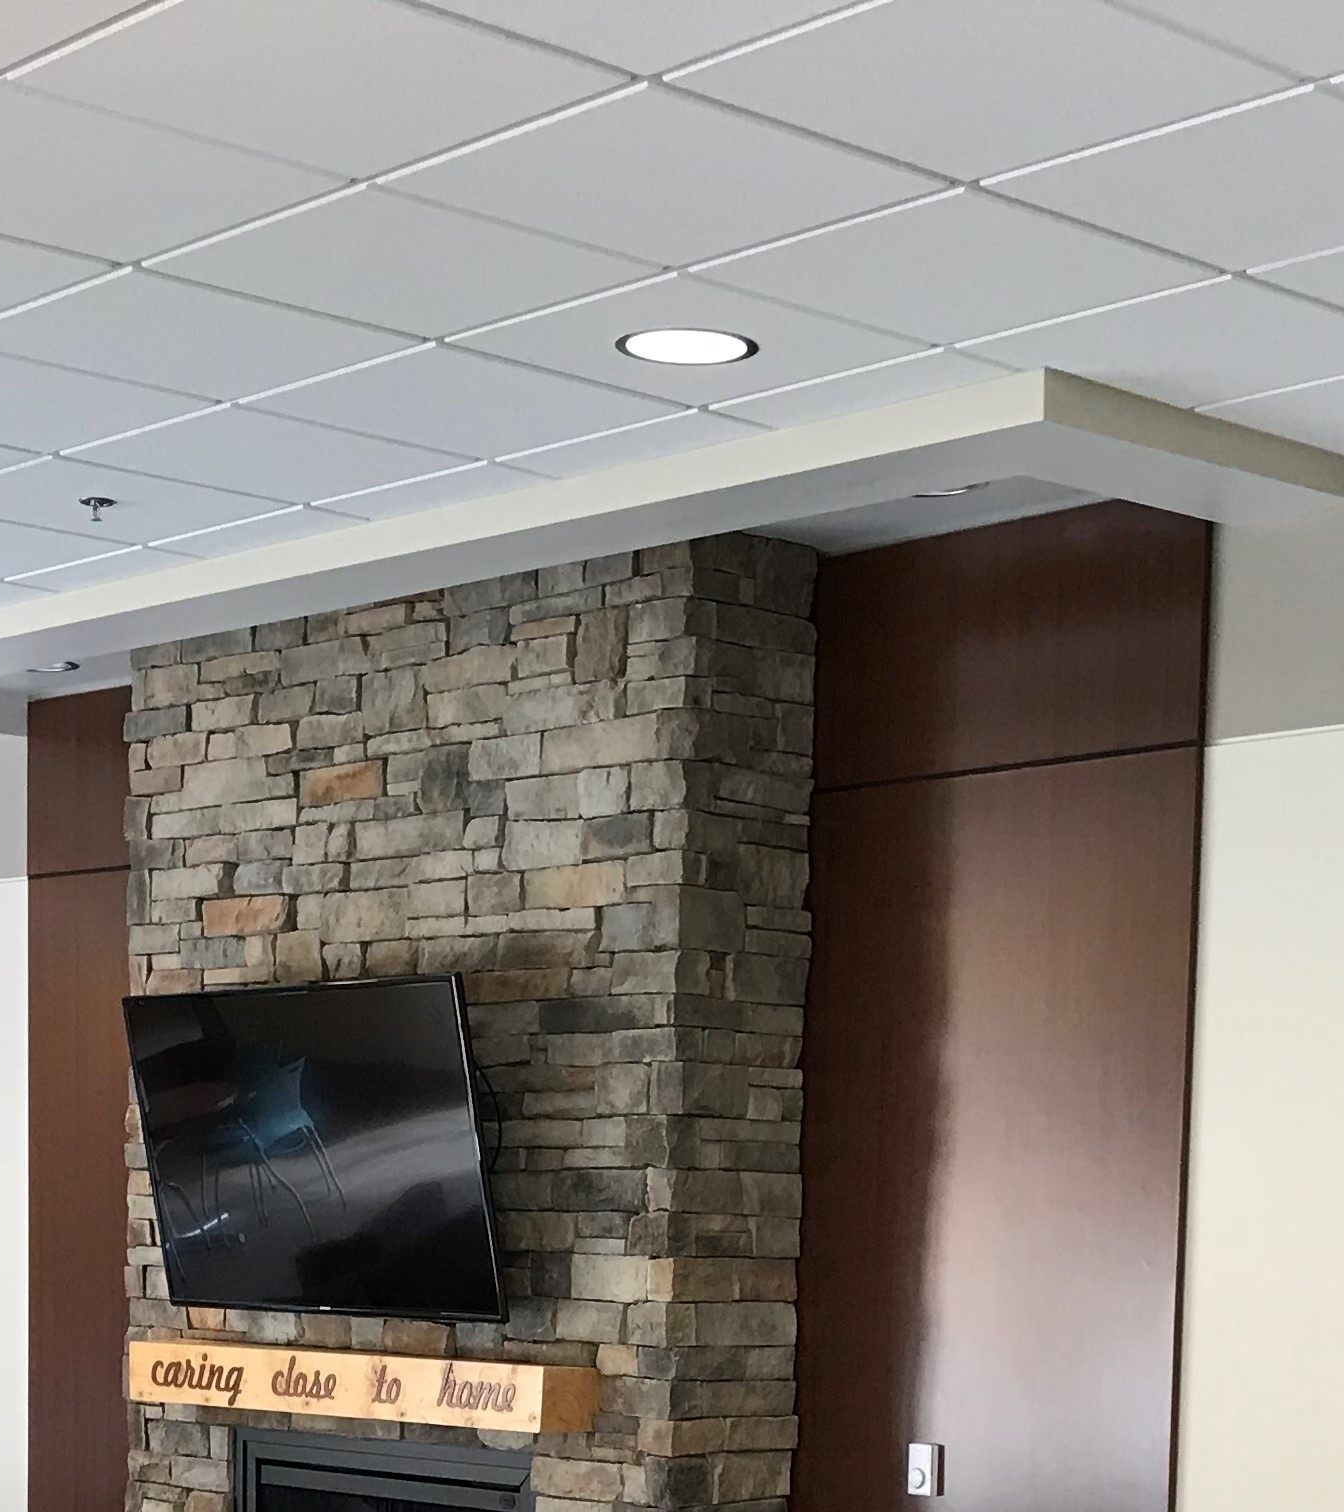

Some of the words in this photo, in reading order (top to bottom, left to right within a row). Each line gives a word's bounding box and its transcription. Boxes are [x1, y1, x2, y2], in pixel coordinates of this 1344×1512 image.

[150, 1352, 245, 1407] caring
[271, 1355, 337, 1401] close
[372, 1364, 402, 1405] to
[436, 1362, 517, 1413] home
